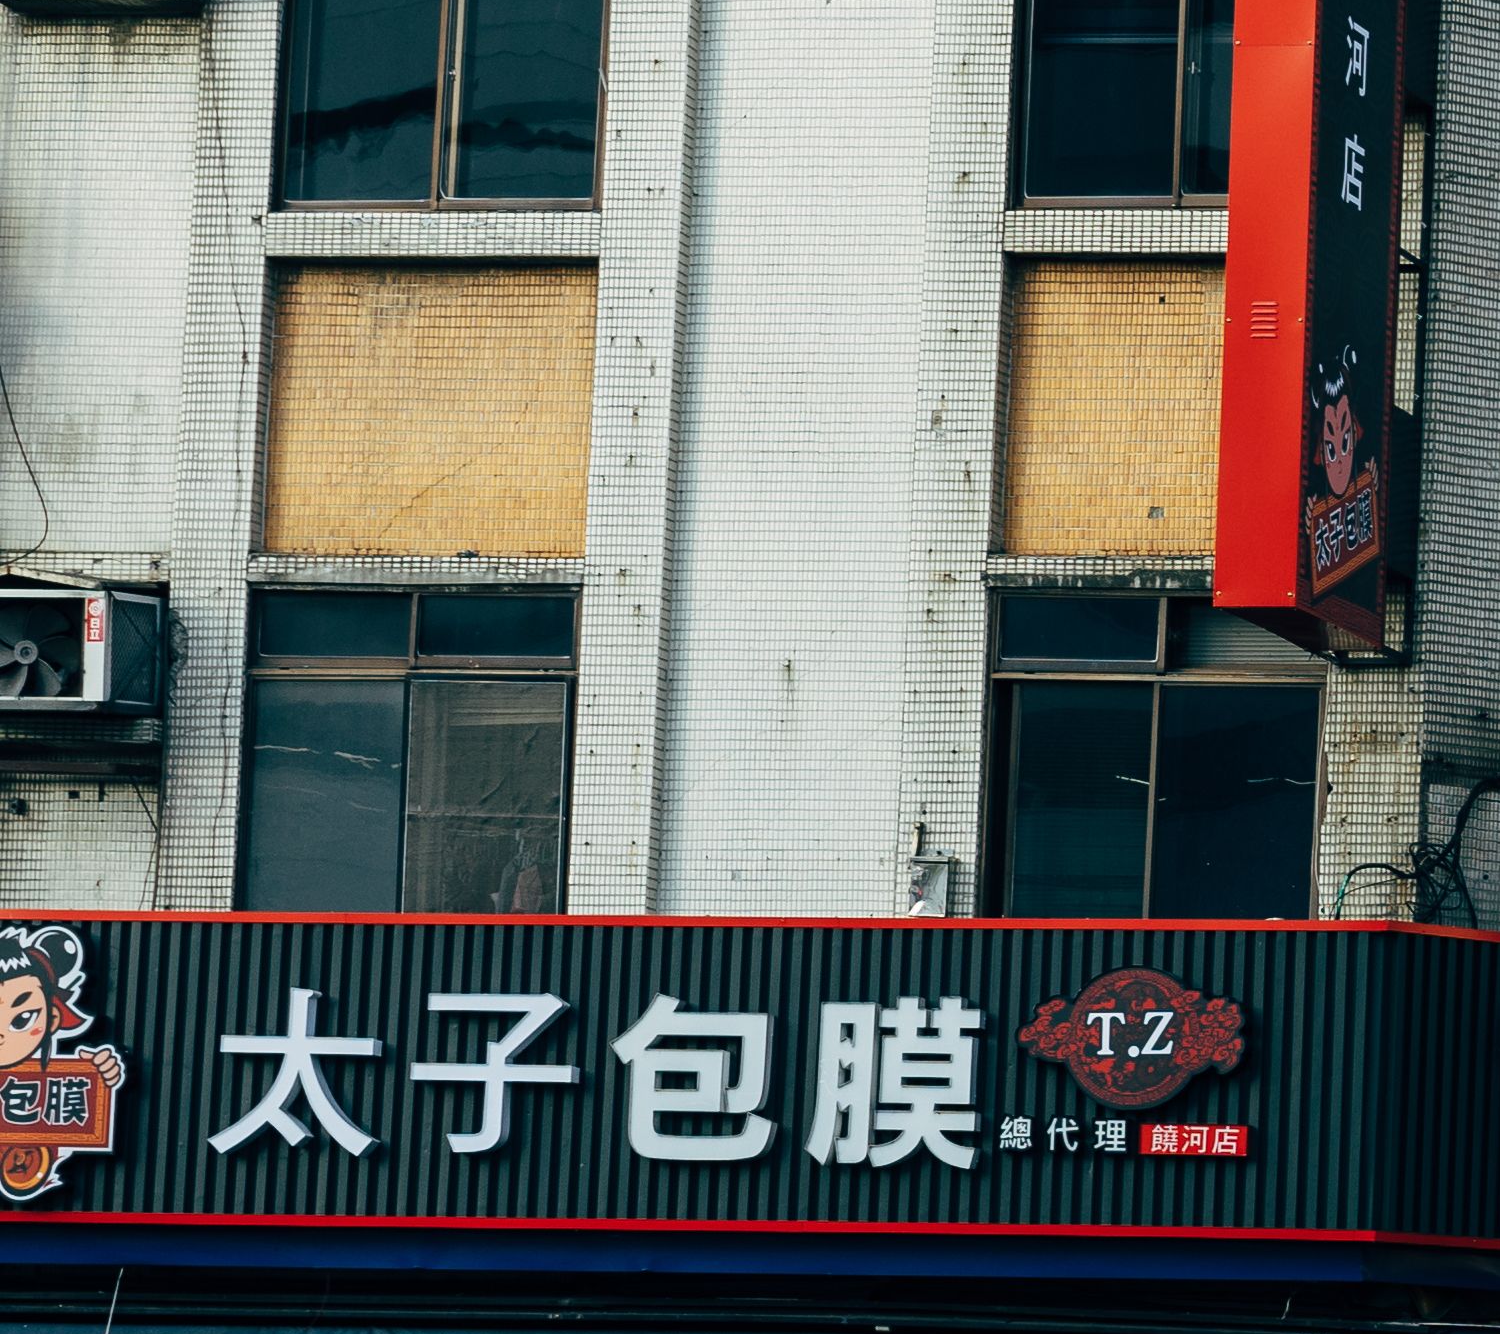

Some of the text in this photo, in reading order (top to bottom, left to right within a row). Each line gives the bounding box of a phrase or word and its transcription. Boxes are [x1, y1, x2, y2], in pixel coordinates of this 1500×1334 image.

[1315, 488, 1373, 573] 太子包膜
[1086, 1008, 1176, 1059] T.Z
[0, 1075, 90, 1126] 包膜
[207, 986, 985, 1171] 太子包膜
[999, 1116, 1240, 1157] 總代理 饒河店
